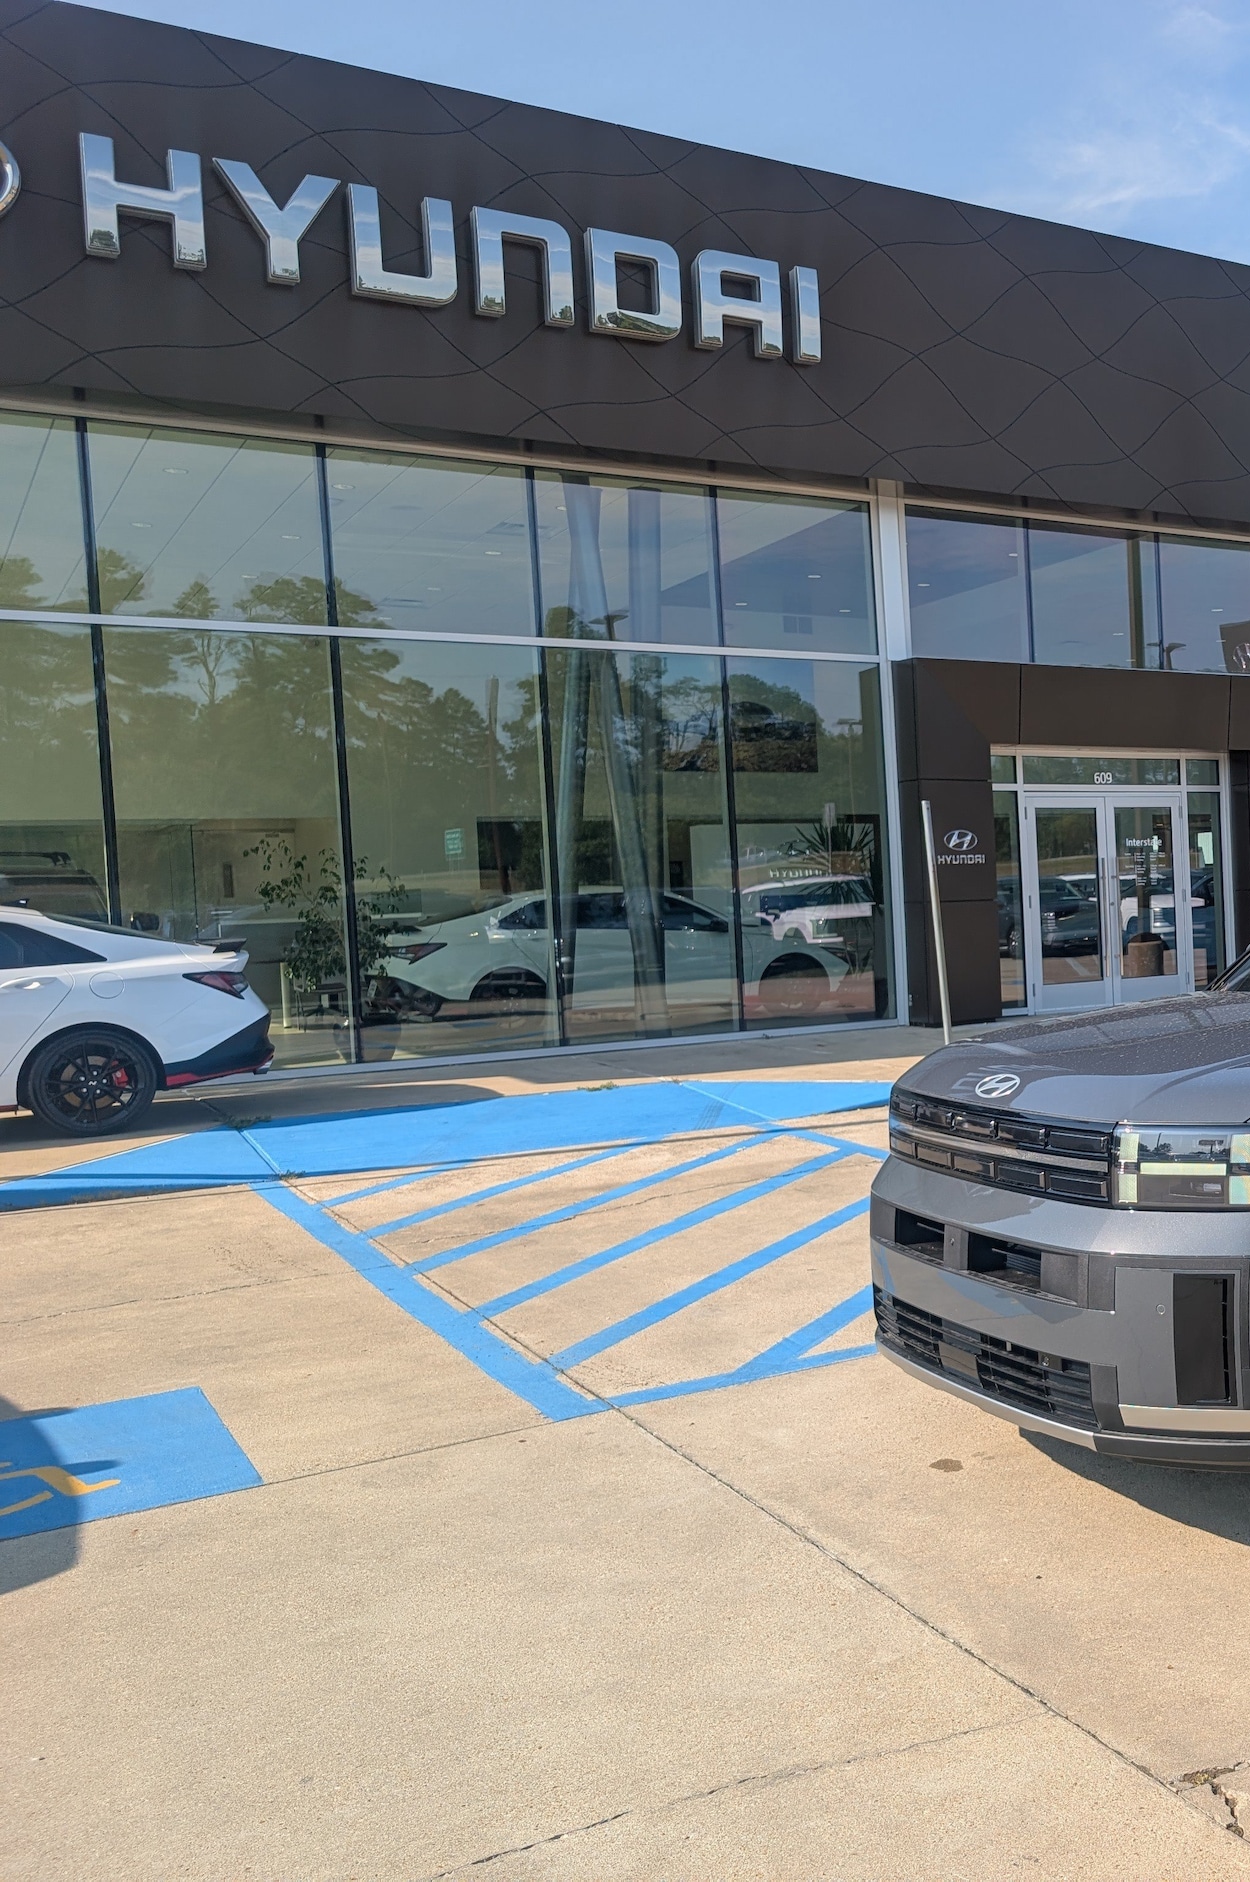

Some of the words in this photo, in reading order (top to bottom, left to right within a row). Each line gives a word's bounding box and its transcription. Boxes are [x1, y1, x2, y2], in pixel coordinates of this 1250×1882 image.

[79, 131, 822, 366] HYUNDAI
[1094, 771, 1113, 785] 609
[937, 853, 986, 865] HYUNDAI
